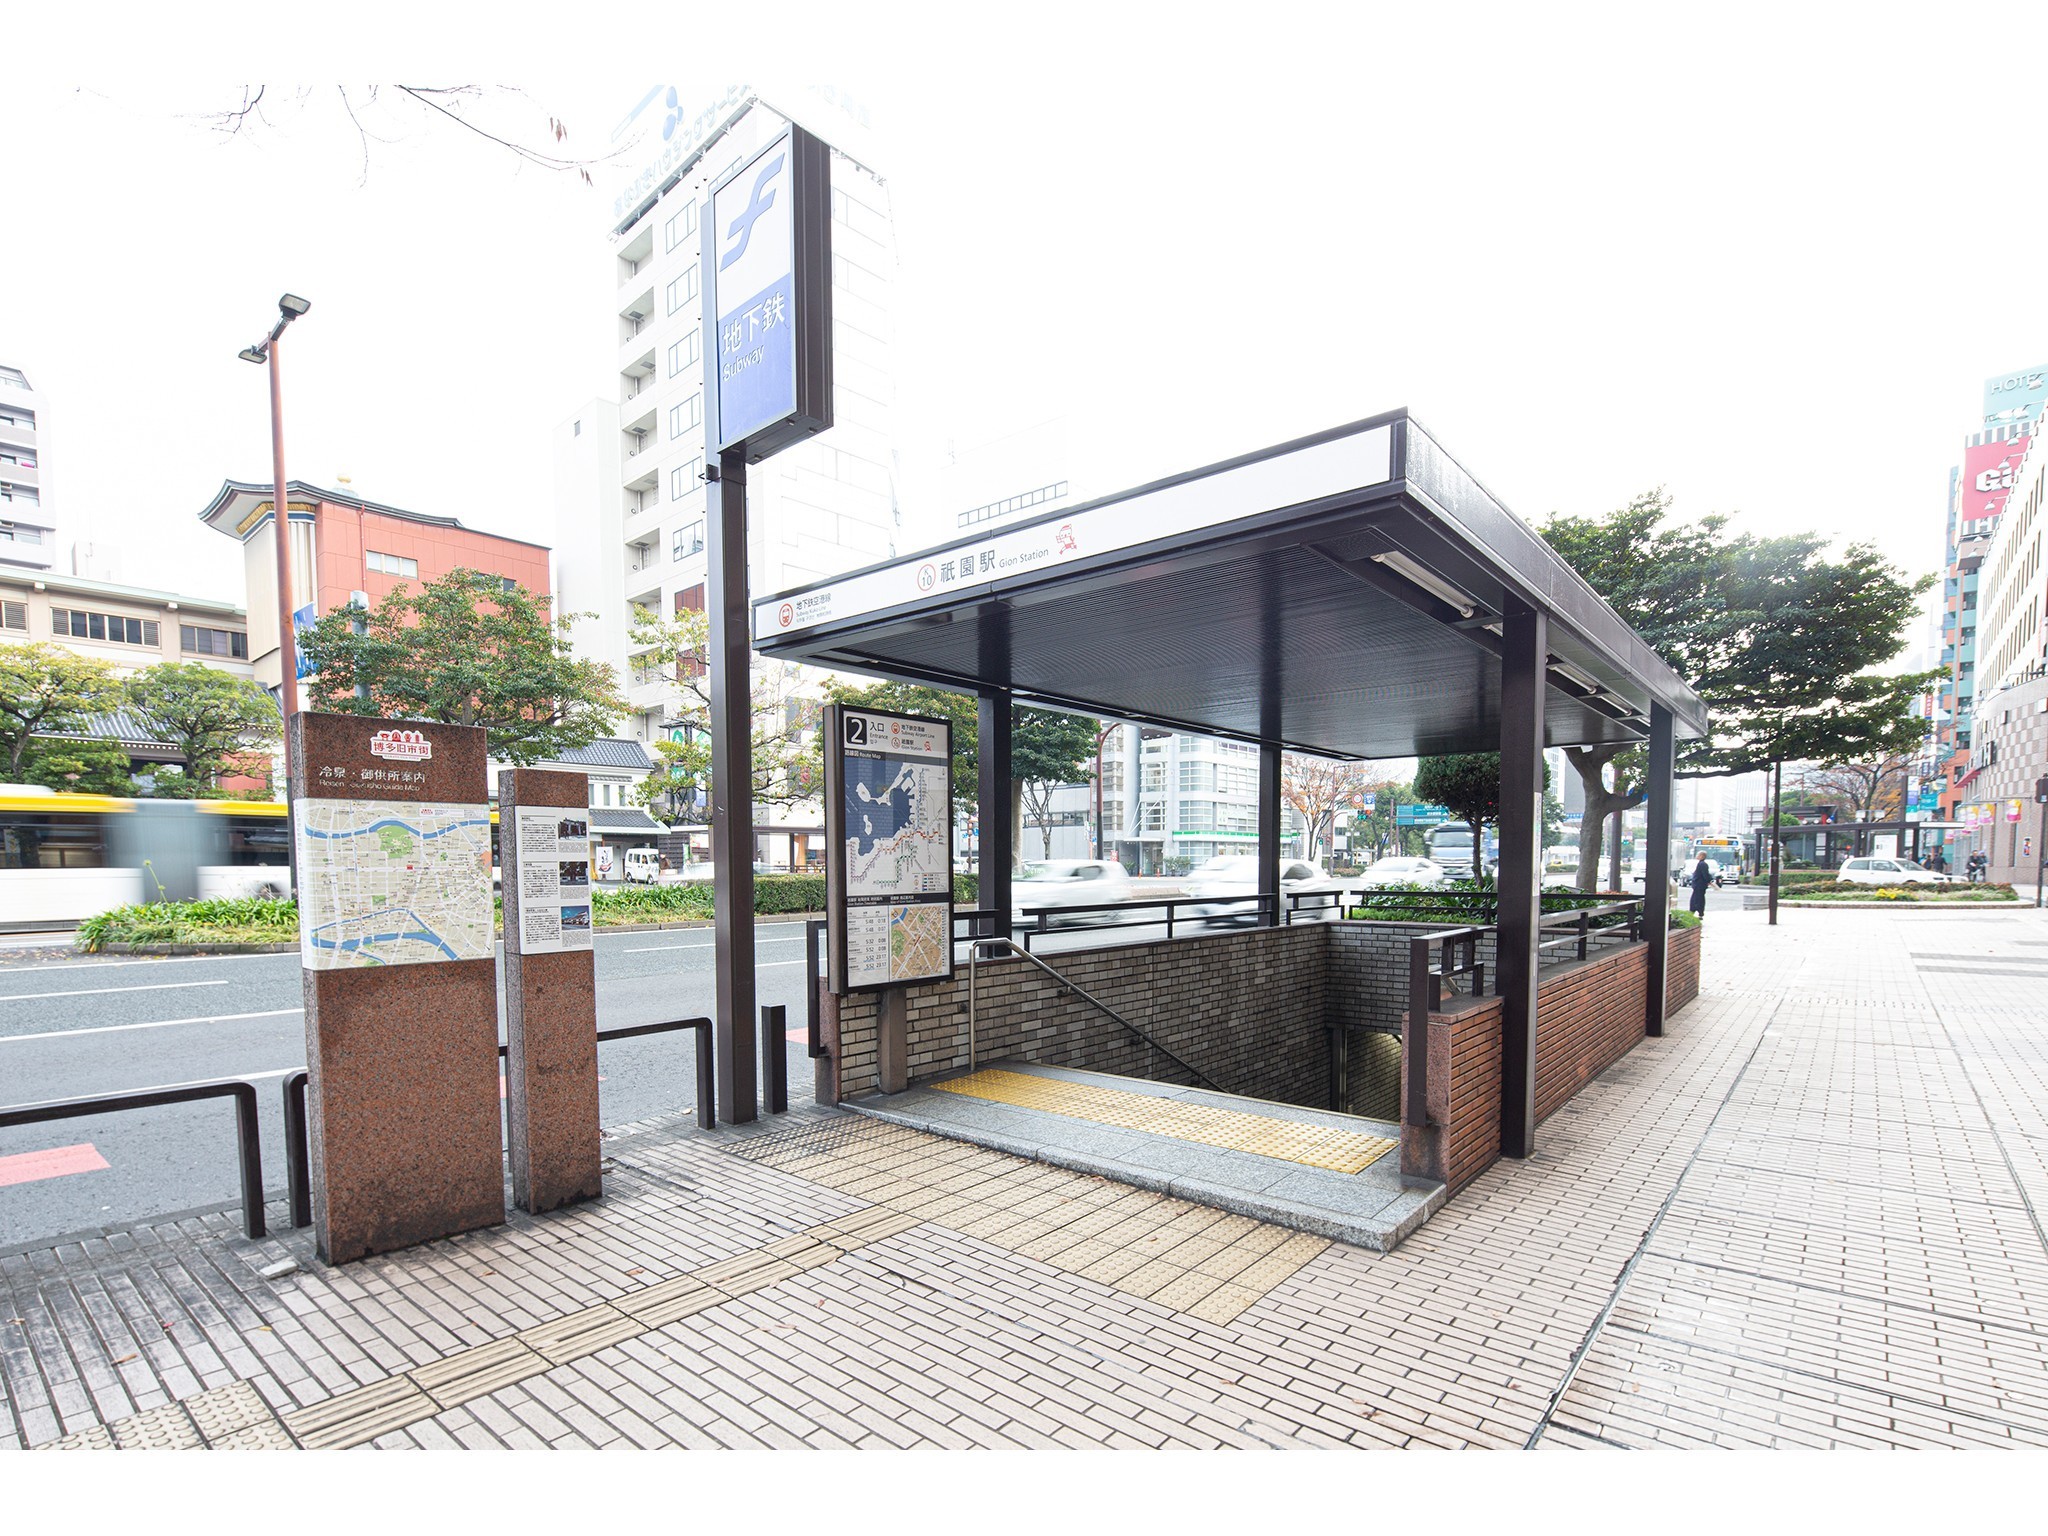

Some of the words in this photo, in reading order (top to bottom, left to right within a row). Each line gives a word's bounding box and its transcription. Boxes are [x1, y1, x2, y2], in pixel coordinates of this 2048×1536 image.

[722, 291, 785, 357] 地下鉄
[722, 343, 766, 382] Subway
[1991, 372, 2044, 395] HOTE
[940, 550, 996, 583] 祇園駅
[999, 556, 1018, 568] Gion
[1020, 549, 1049, 563] Station
[922, 574, 933, 587] 10
[851, 718, 863, 743] 2
[870, 721, 885, 732] 入口
[373, 742, 429, 755] 博多旧市街
